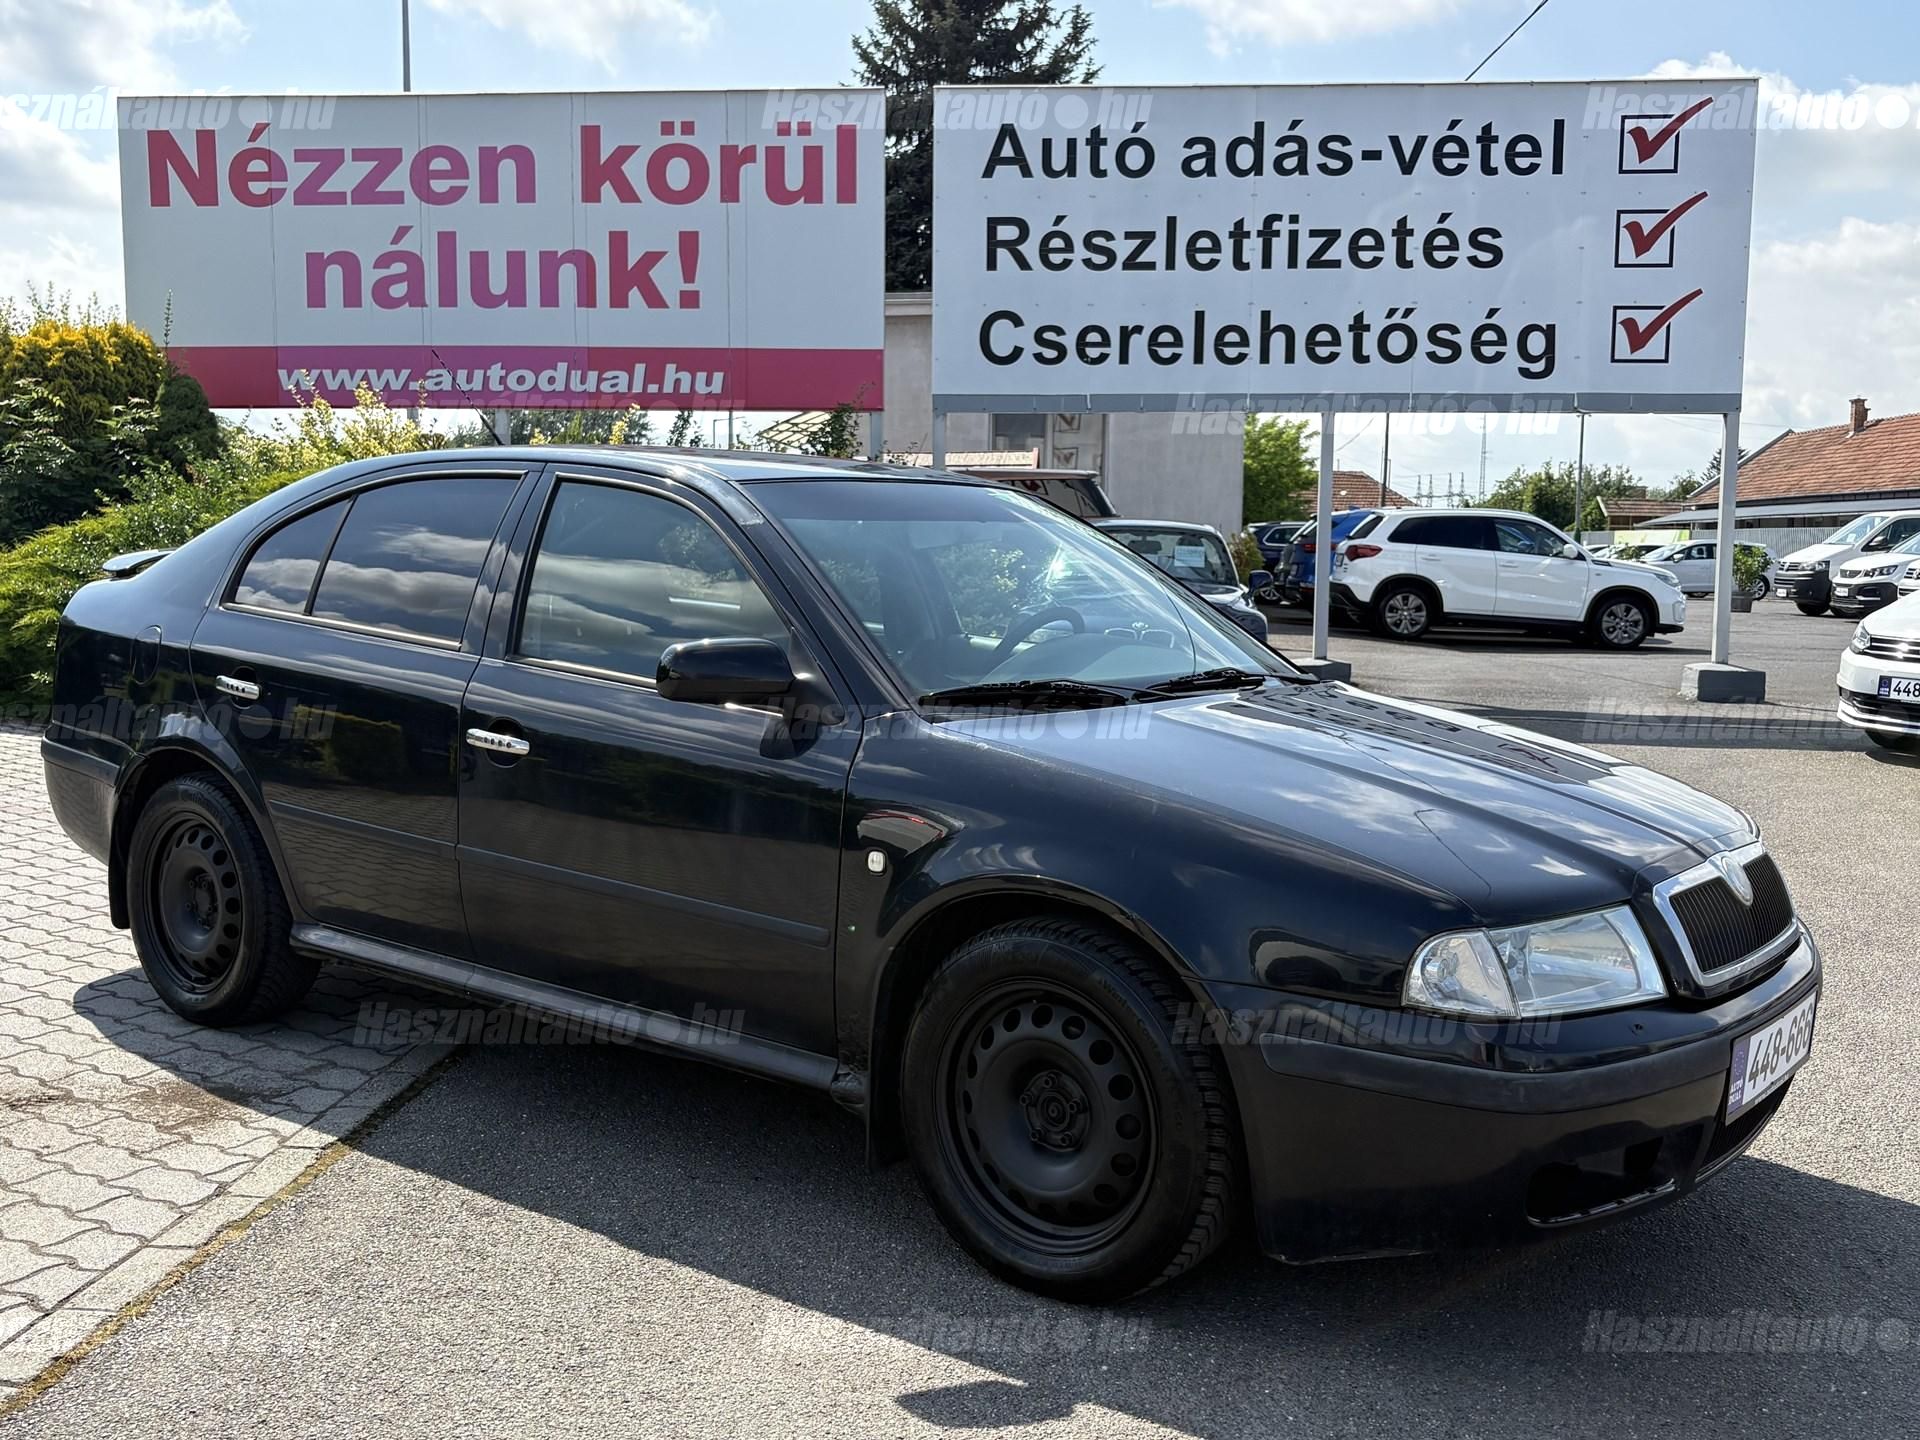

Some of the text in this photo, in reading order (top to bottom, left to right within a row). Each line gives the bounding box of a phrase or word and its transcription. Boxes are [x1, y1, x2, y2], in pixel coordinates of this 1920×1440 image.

[147, 121, 857, 207] Nézzen körül
[981, 118, 1565, 179] Autó adás-vétel
[305, 226, 700, 310] nálunk!
[986, 212, 1505, 272] Részletfizetés
[278, 362, 725, 394] www.autodual.hu
[979, 307, 1557, 380] Cserelehetőség
[1748, 1002, 1814, 1090] 448-666
